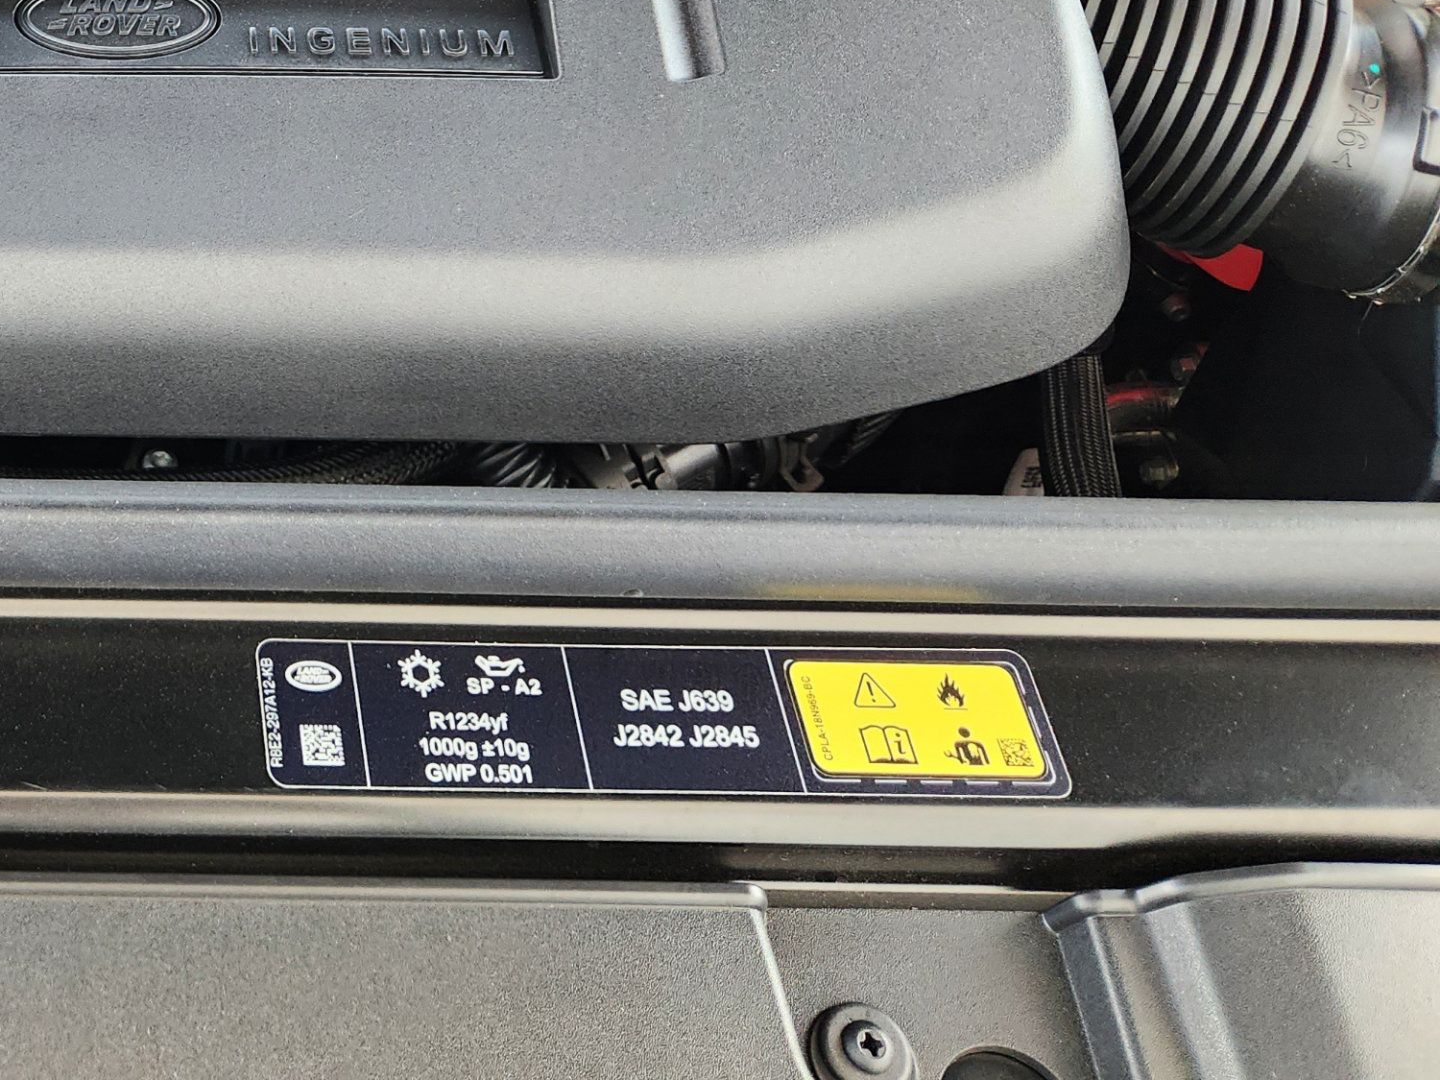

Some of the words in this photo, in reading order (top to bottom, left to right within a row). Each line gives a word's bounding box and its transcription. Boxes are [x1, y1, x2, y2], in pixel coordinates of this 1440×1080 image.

[66, 13, 181, 36] ROVER
[248, 26, 515, 57] INGENIUM
[466, 677, 495, 695] SP
[514, 678, 543, 696] A2
[620, 688, 674, 711] SAE
[678, 689, 734, 712] J639
[428, 711, 509, 736] R1234yf
[613, 724, 685, 748] J2842
[688, 724, 760, 748] J2845
[418, 737, 479, 761] 1000g
[481, 738, 531, 762] ±10g
[424, 762, 477, 783] GWP
[479, 763, 533, 784] 0.501
